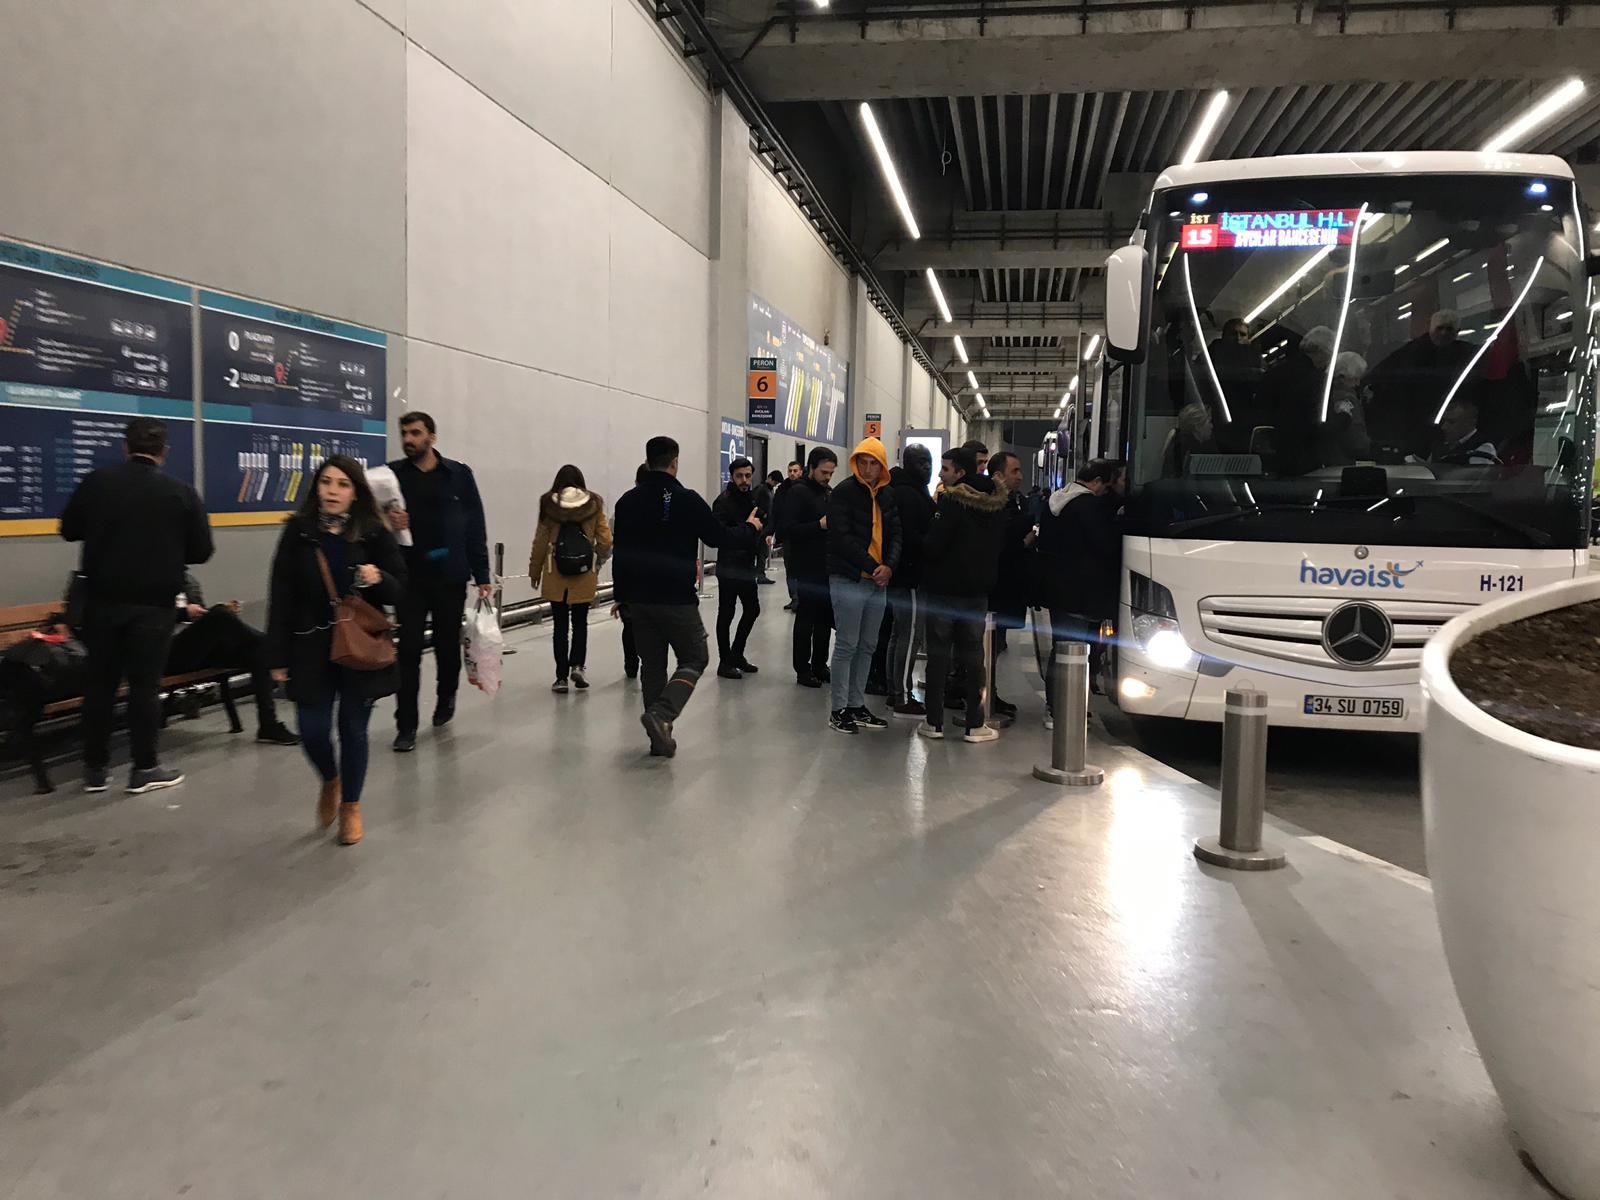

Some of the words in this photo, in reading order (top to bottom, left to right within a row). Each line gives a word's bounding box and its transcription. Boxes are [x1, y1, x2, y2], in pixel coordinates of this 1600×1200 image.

[1187, 229, 1213, 245] 15
[757, 376, 769, 392] 6
[870, 424, 876, 434] 5
[1300, 558, 1405, 589] havaist
[1480, 574, 1523, 592] H-121
[1314, 698, 1333, 713] 34
[1337, 699, 1356, 714] SU
[1363, 700, 1401, 715] 0759
